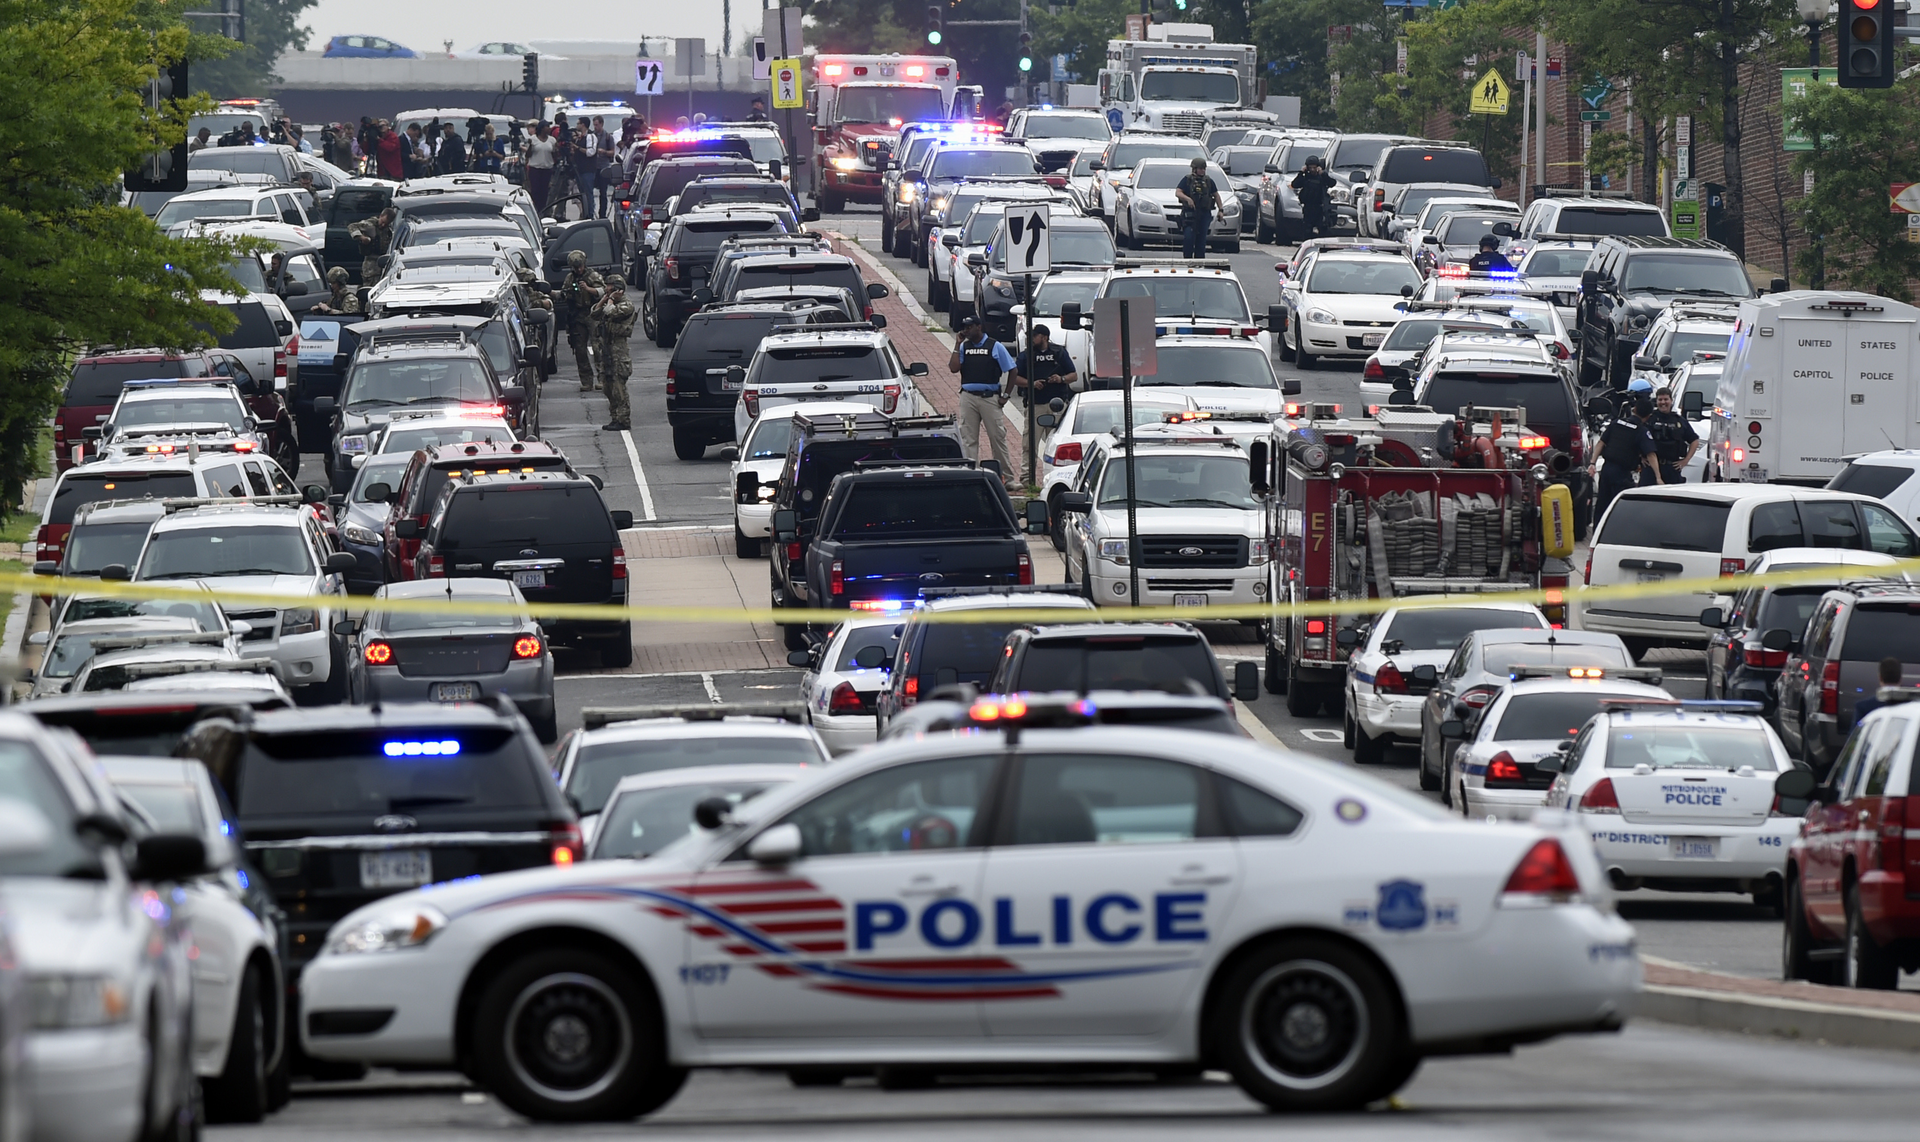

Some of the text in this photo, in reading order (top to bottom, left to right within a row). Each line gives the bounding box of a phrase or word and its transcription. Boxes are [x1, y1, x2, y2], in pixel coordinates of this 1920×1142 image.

[1712, 195, 1721, 207] P
[1798, 339, 1897, 350] UNITED STATES
[1793, 370, 1894, 381] CAPITOL POLICE
[858, 384, 880, 392] 8704
[1311, 512, 1326, 531] E
[1311, 533, 1325, 552] 7
[1661, 784, 1727, 794] METROPOLITAN
[1665, 793, 1723, 806] POLICE
[1609, 832, 1670, 845] DISTRICT
[854, 893, 1210, 952] POLICE
